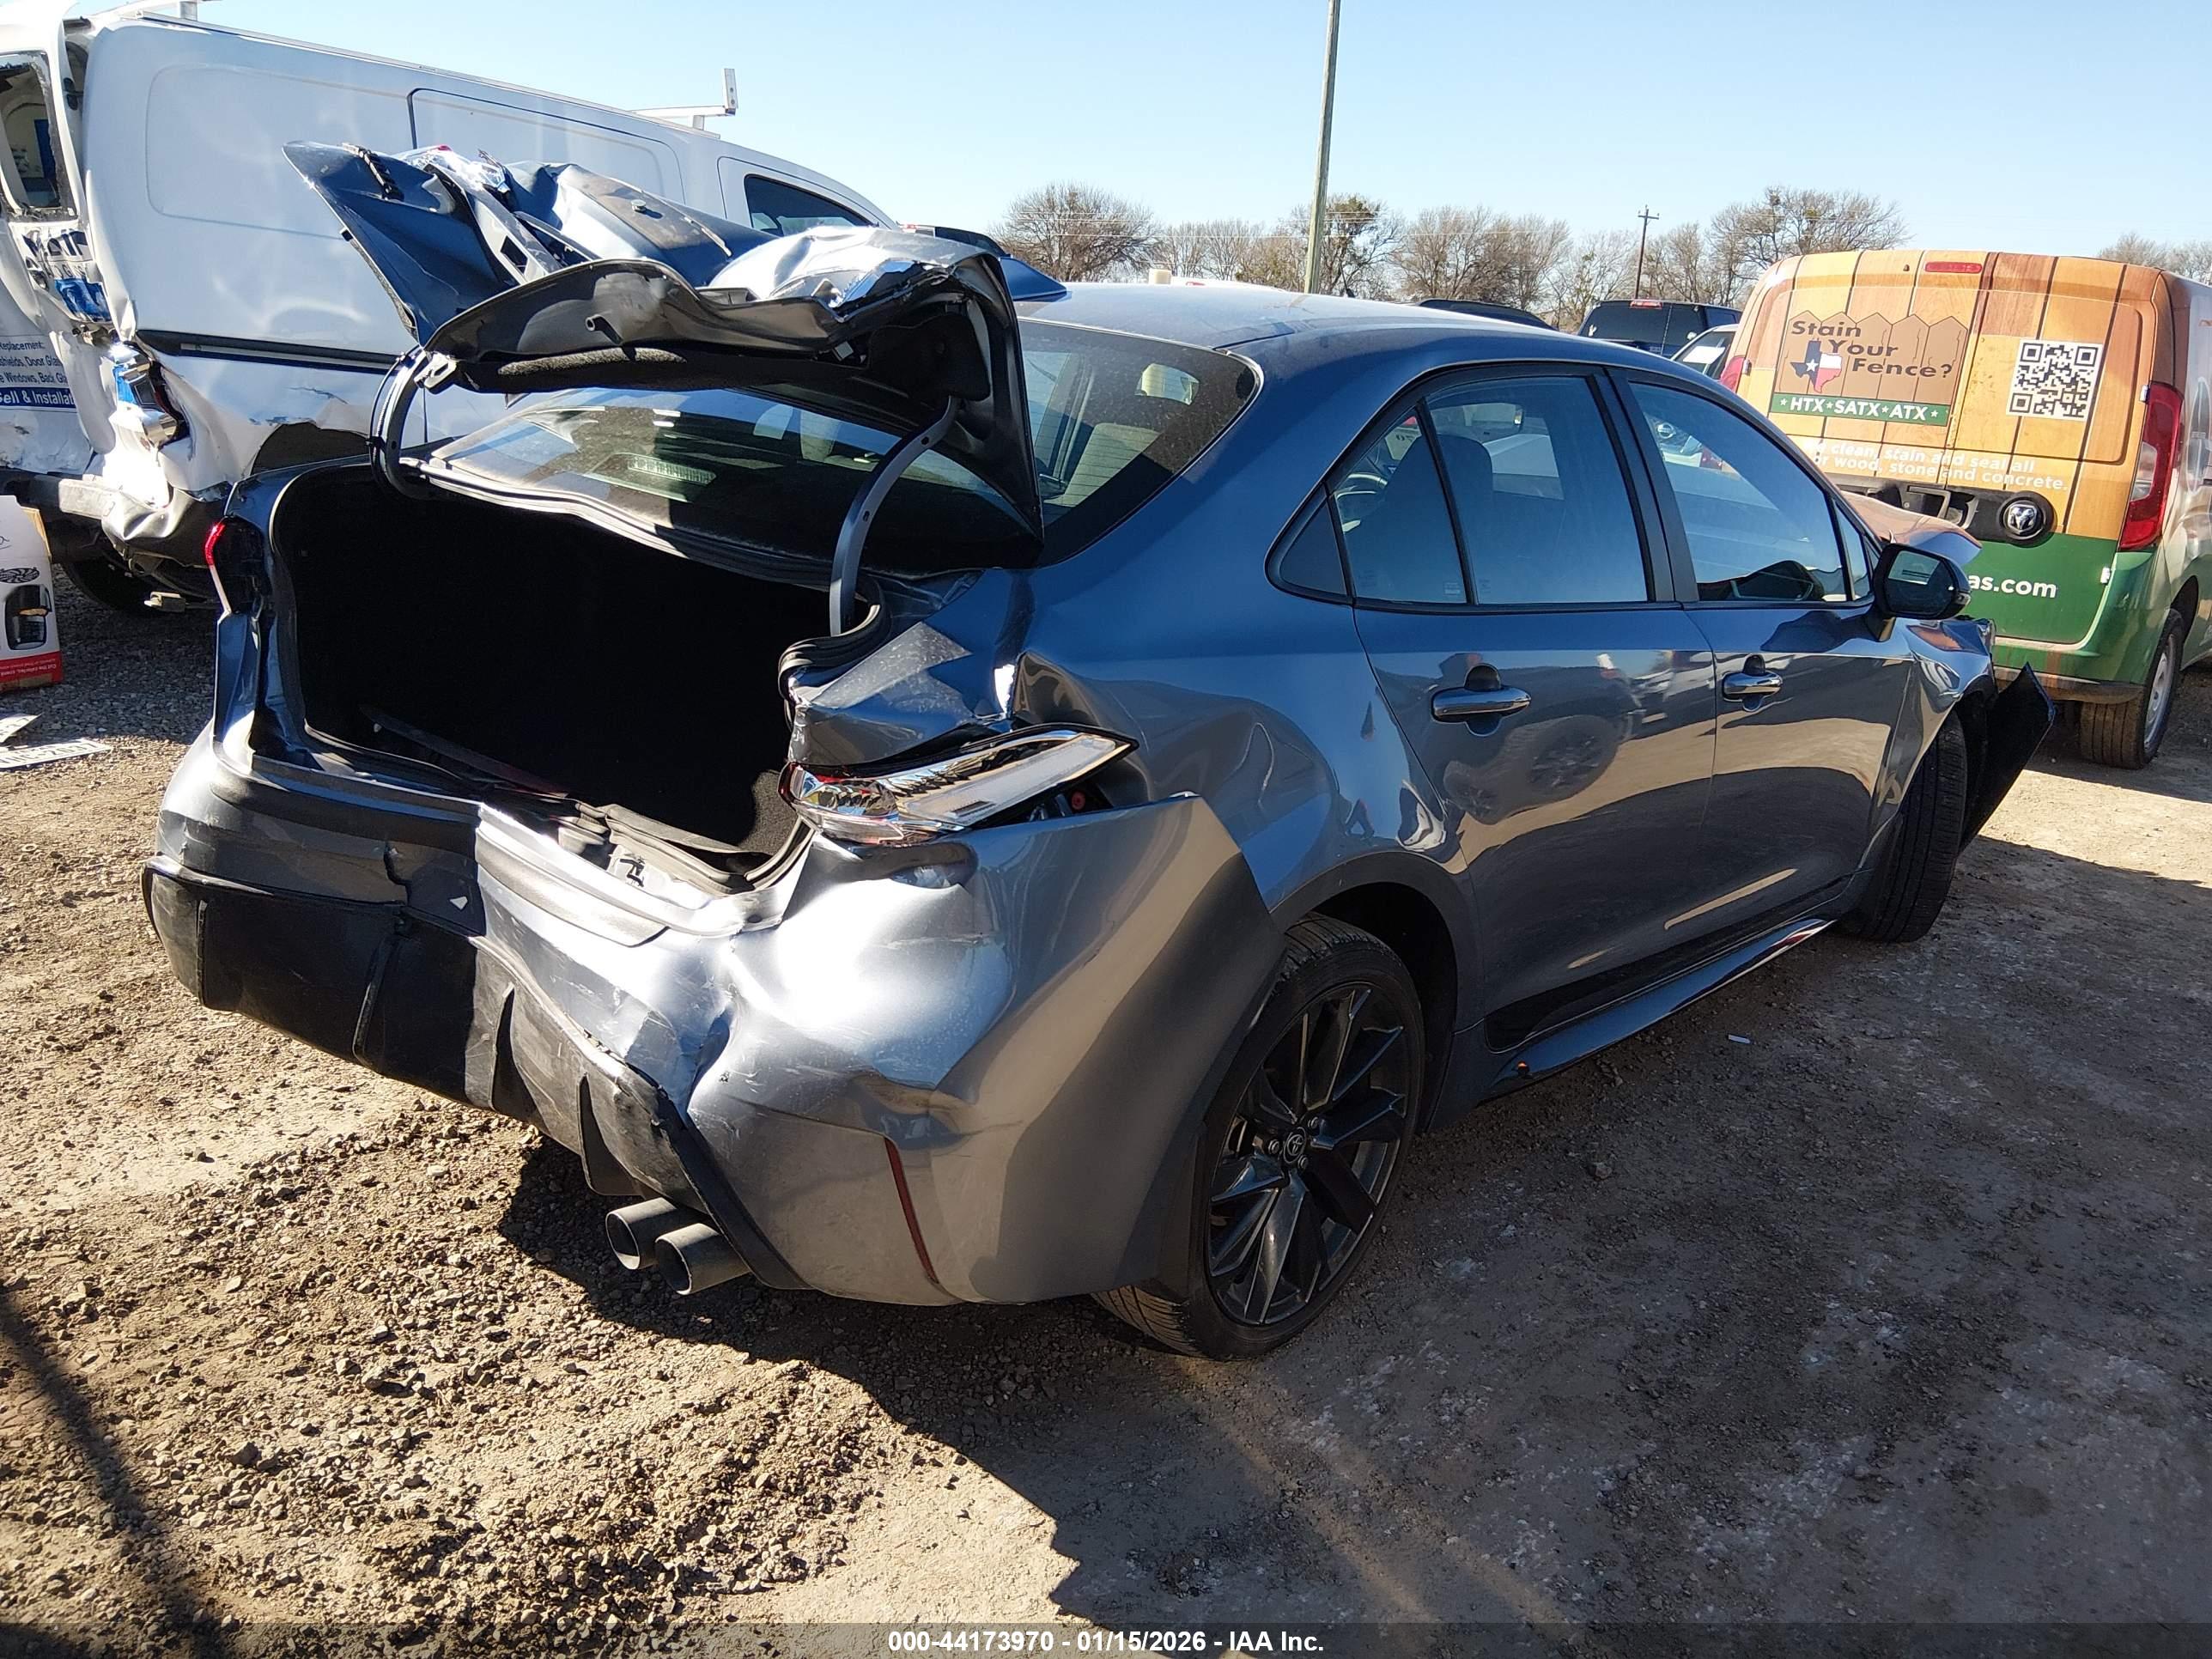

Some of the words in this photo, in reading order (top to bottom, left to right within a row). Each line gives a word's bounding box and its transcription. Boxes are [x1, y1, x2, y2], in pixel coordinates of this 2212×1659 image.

[1791, 320, 1862, 337] Stain
[1828, 339, 1899, 357] Your
[24, 356, 45, 367] Door
[1852, 357, 1953, 379] Fence?
[21, 390, 31, 404] &
[1790, 397, 1824, 413] HTX
[1831, 442, 1879, 459] clean,
[1884, 447, 1926, 462] stain
[1931, 451, 1966, 466] and
[1970, 456, 2008, 471] seal
[2012, 459, 2035, 472] all
[1834, 457, 1883, 472] wood,
[1889, 462, 1937, 477] stone
[1941, 467, 1976, 482] and
[1982, 471, 2068, 490] concrete.
